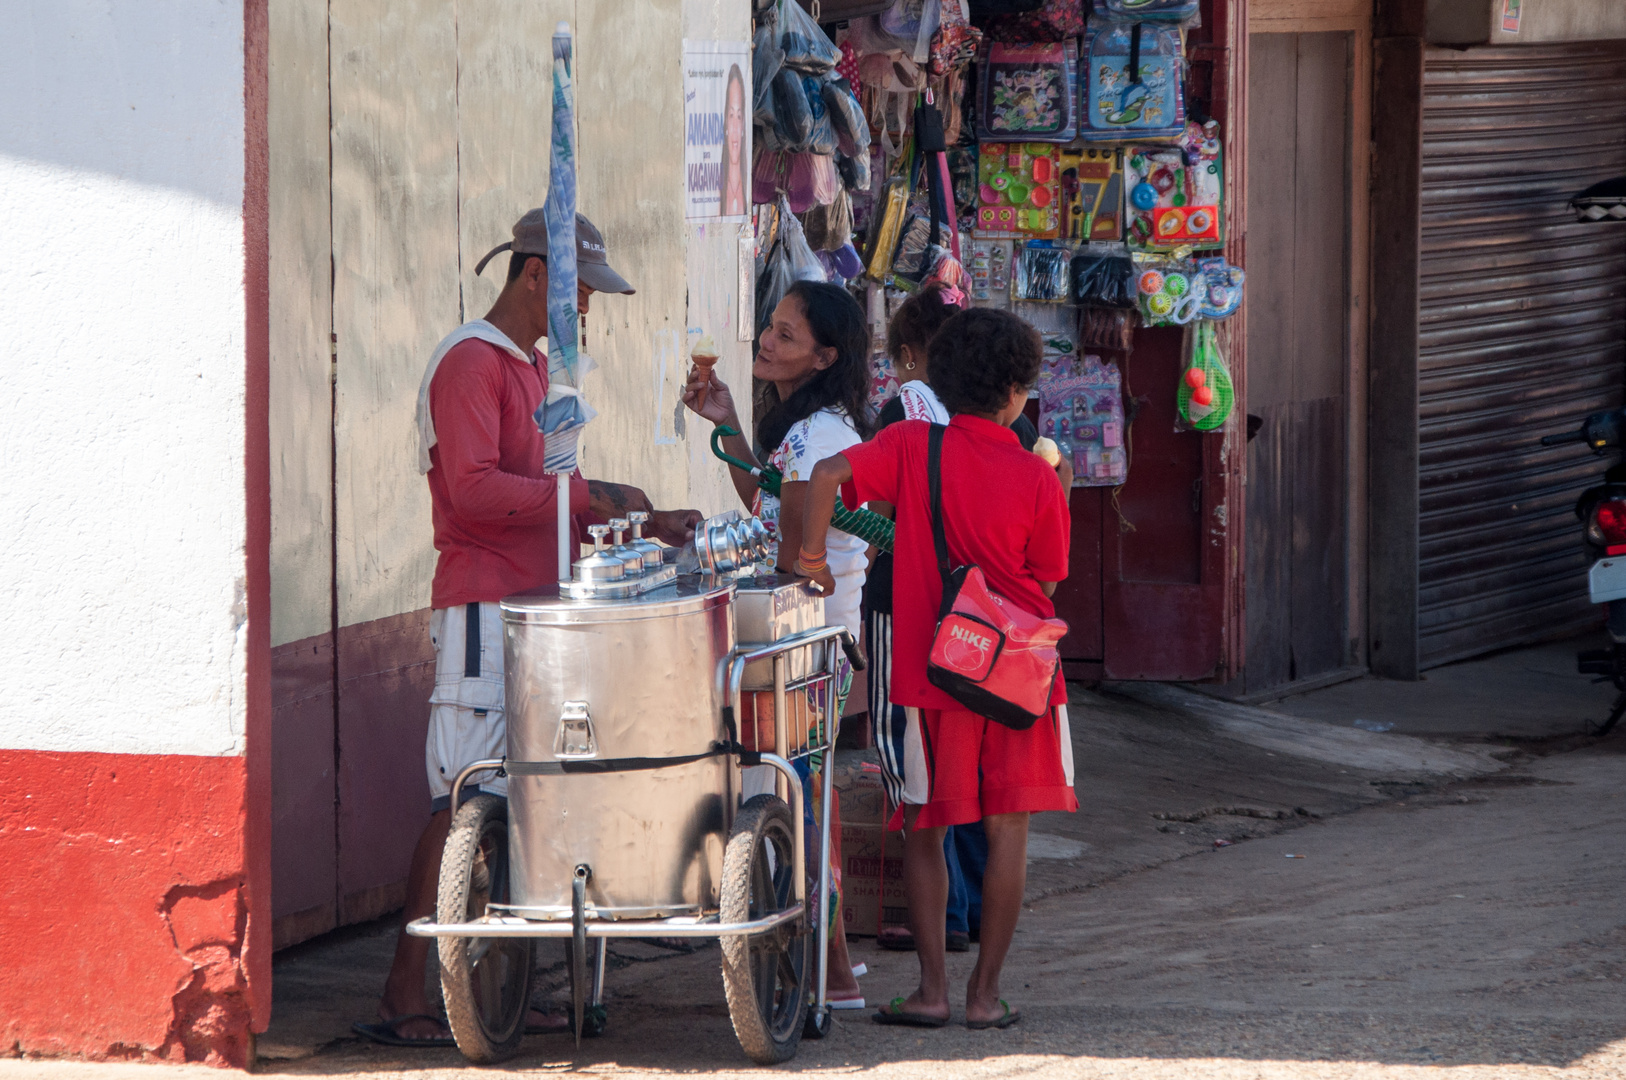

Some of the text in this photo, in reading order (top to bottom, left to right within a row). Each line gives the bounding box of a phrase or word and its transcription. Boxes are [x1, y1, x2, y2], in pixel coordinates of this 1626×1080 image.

[687, 113, 725, 146] AMANDA
[687, 163, 723, 192] KAGAWAD
[951, 625, 992, 651] NIKE
